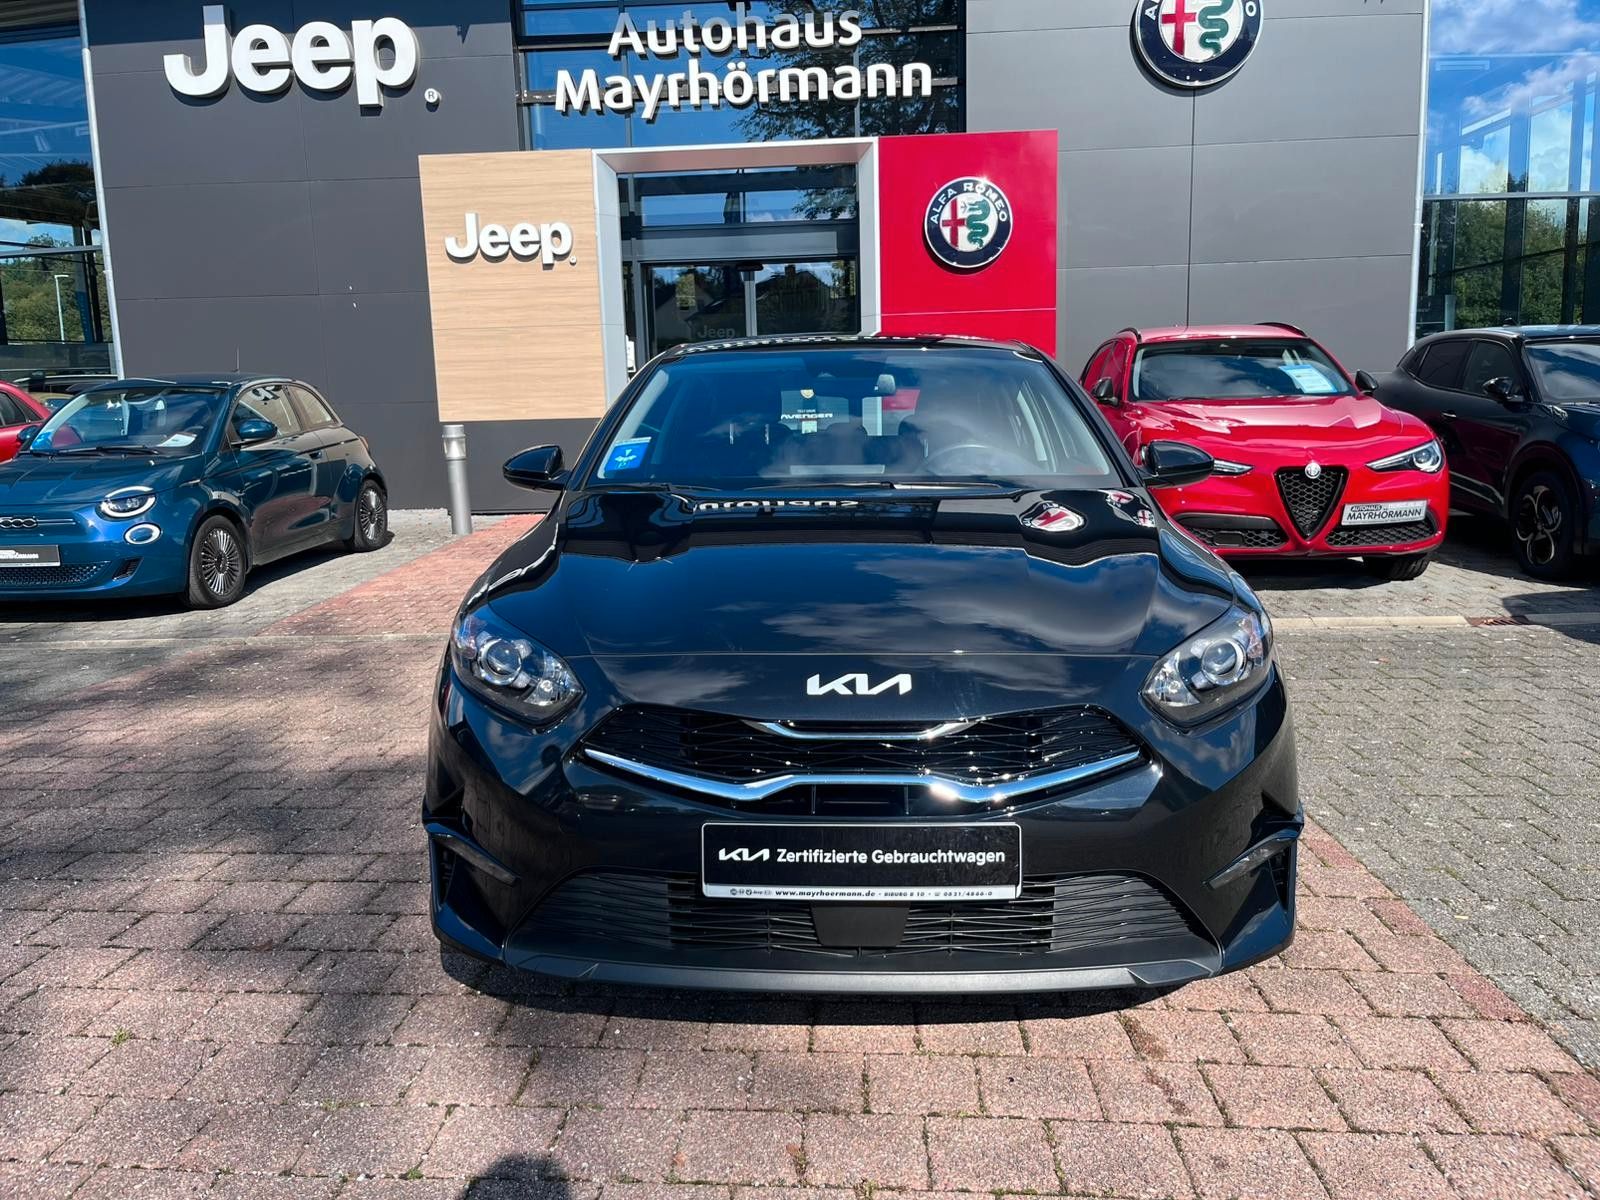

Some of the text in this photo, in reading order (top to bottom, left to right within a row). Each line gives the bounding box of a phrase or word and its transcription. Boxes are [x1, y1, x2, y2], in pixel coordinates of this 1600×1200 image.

[607, 2, 863, 57] Autohaus
[163, 4, 418, 106] Jeep
[555, 58, 933, 121] Mayrhörmann
[930, 182, 1007, 224] ALFA ROMEO
[444, 212, 574, 264] Jeep
[1347, 507, 1422, 521] MAYRHÖRMANN
[806, 673, 913, 695] KIA
[718, 847, 1006, 866] KIA Zertifizierte Gebrauchtwagen
[775, 889, 876, 898] www.mayrhoermann.de
